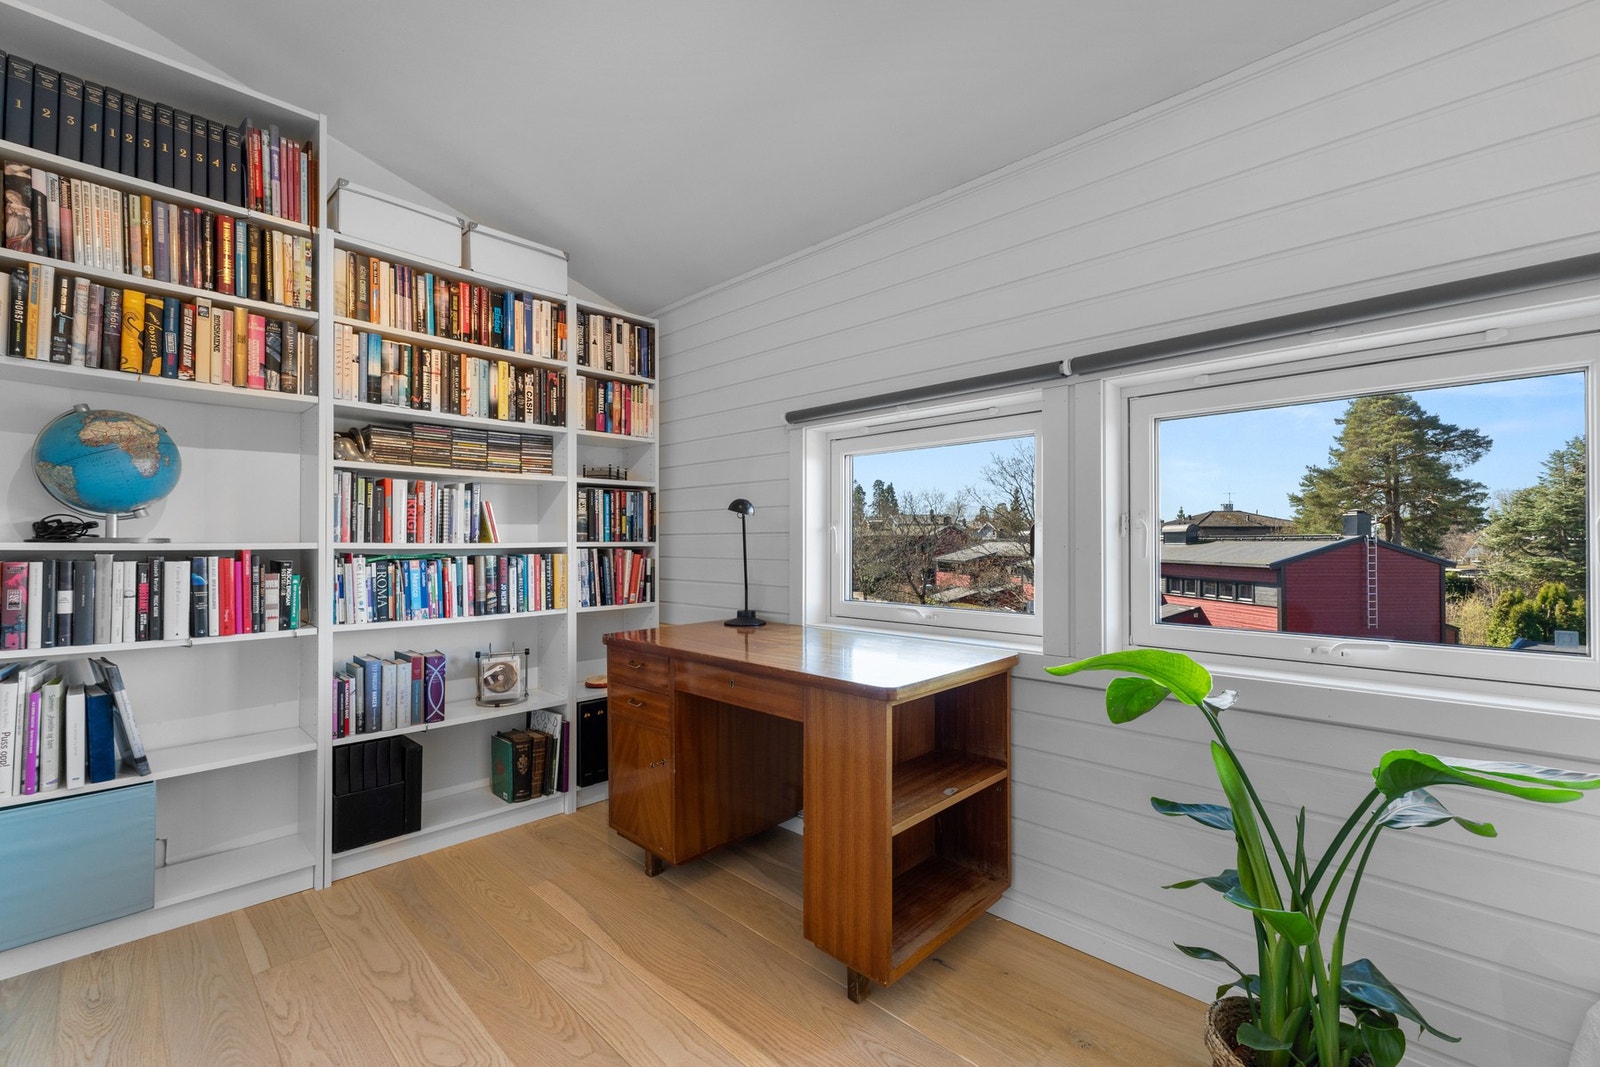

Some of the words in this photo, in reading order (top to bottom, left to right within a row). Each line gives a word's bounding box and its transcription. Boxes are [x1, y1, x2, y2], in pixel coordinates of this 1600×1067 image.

[15, 99, 23, 110] 1
[42, 108, 51, 119] 2
[66, 115, 75, 126] 3
[89, 123, 97, 133] 4
[109, 128, 116, 138] 1
[125, 133, 133, 143] 2
[143, 138, 150, 148] 3
[162, 143, 168, 152] 1
[180, 149, 187, 158] 2
[196, 153, 203, 162] 3
[212, 159, 220, 168] 4
[230, 163, 237, 172] 5
[110, 291, 119, 310] Anne
[14, 300, 24, 323] HORST
[110, 312, 118, 328] Holt
[148, 326, 157, 358] ODYSSEEN
[407, 499, 416, 533] KRIG!
[377, 572, 387, 608] ROMA
[1, 732, 10, 750] Puss
[0, 751, 10, 768] opp!
